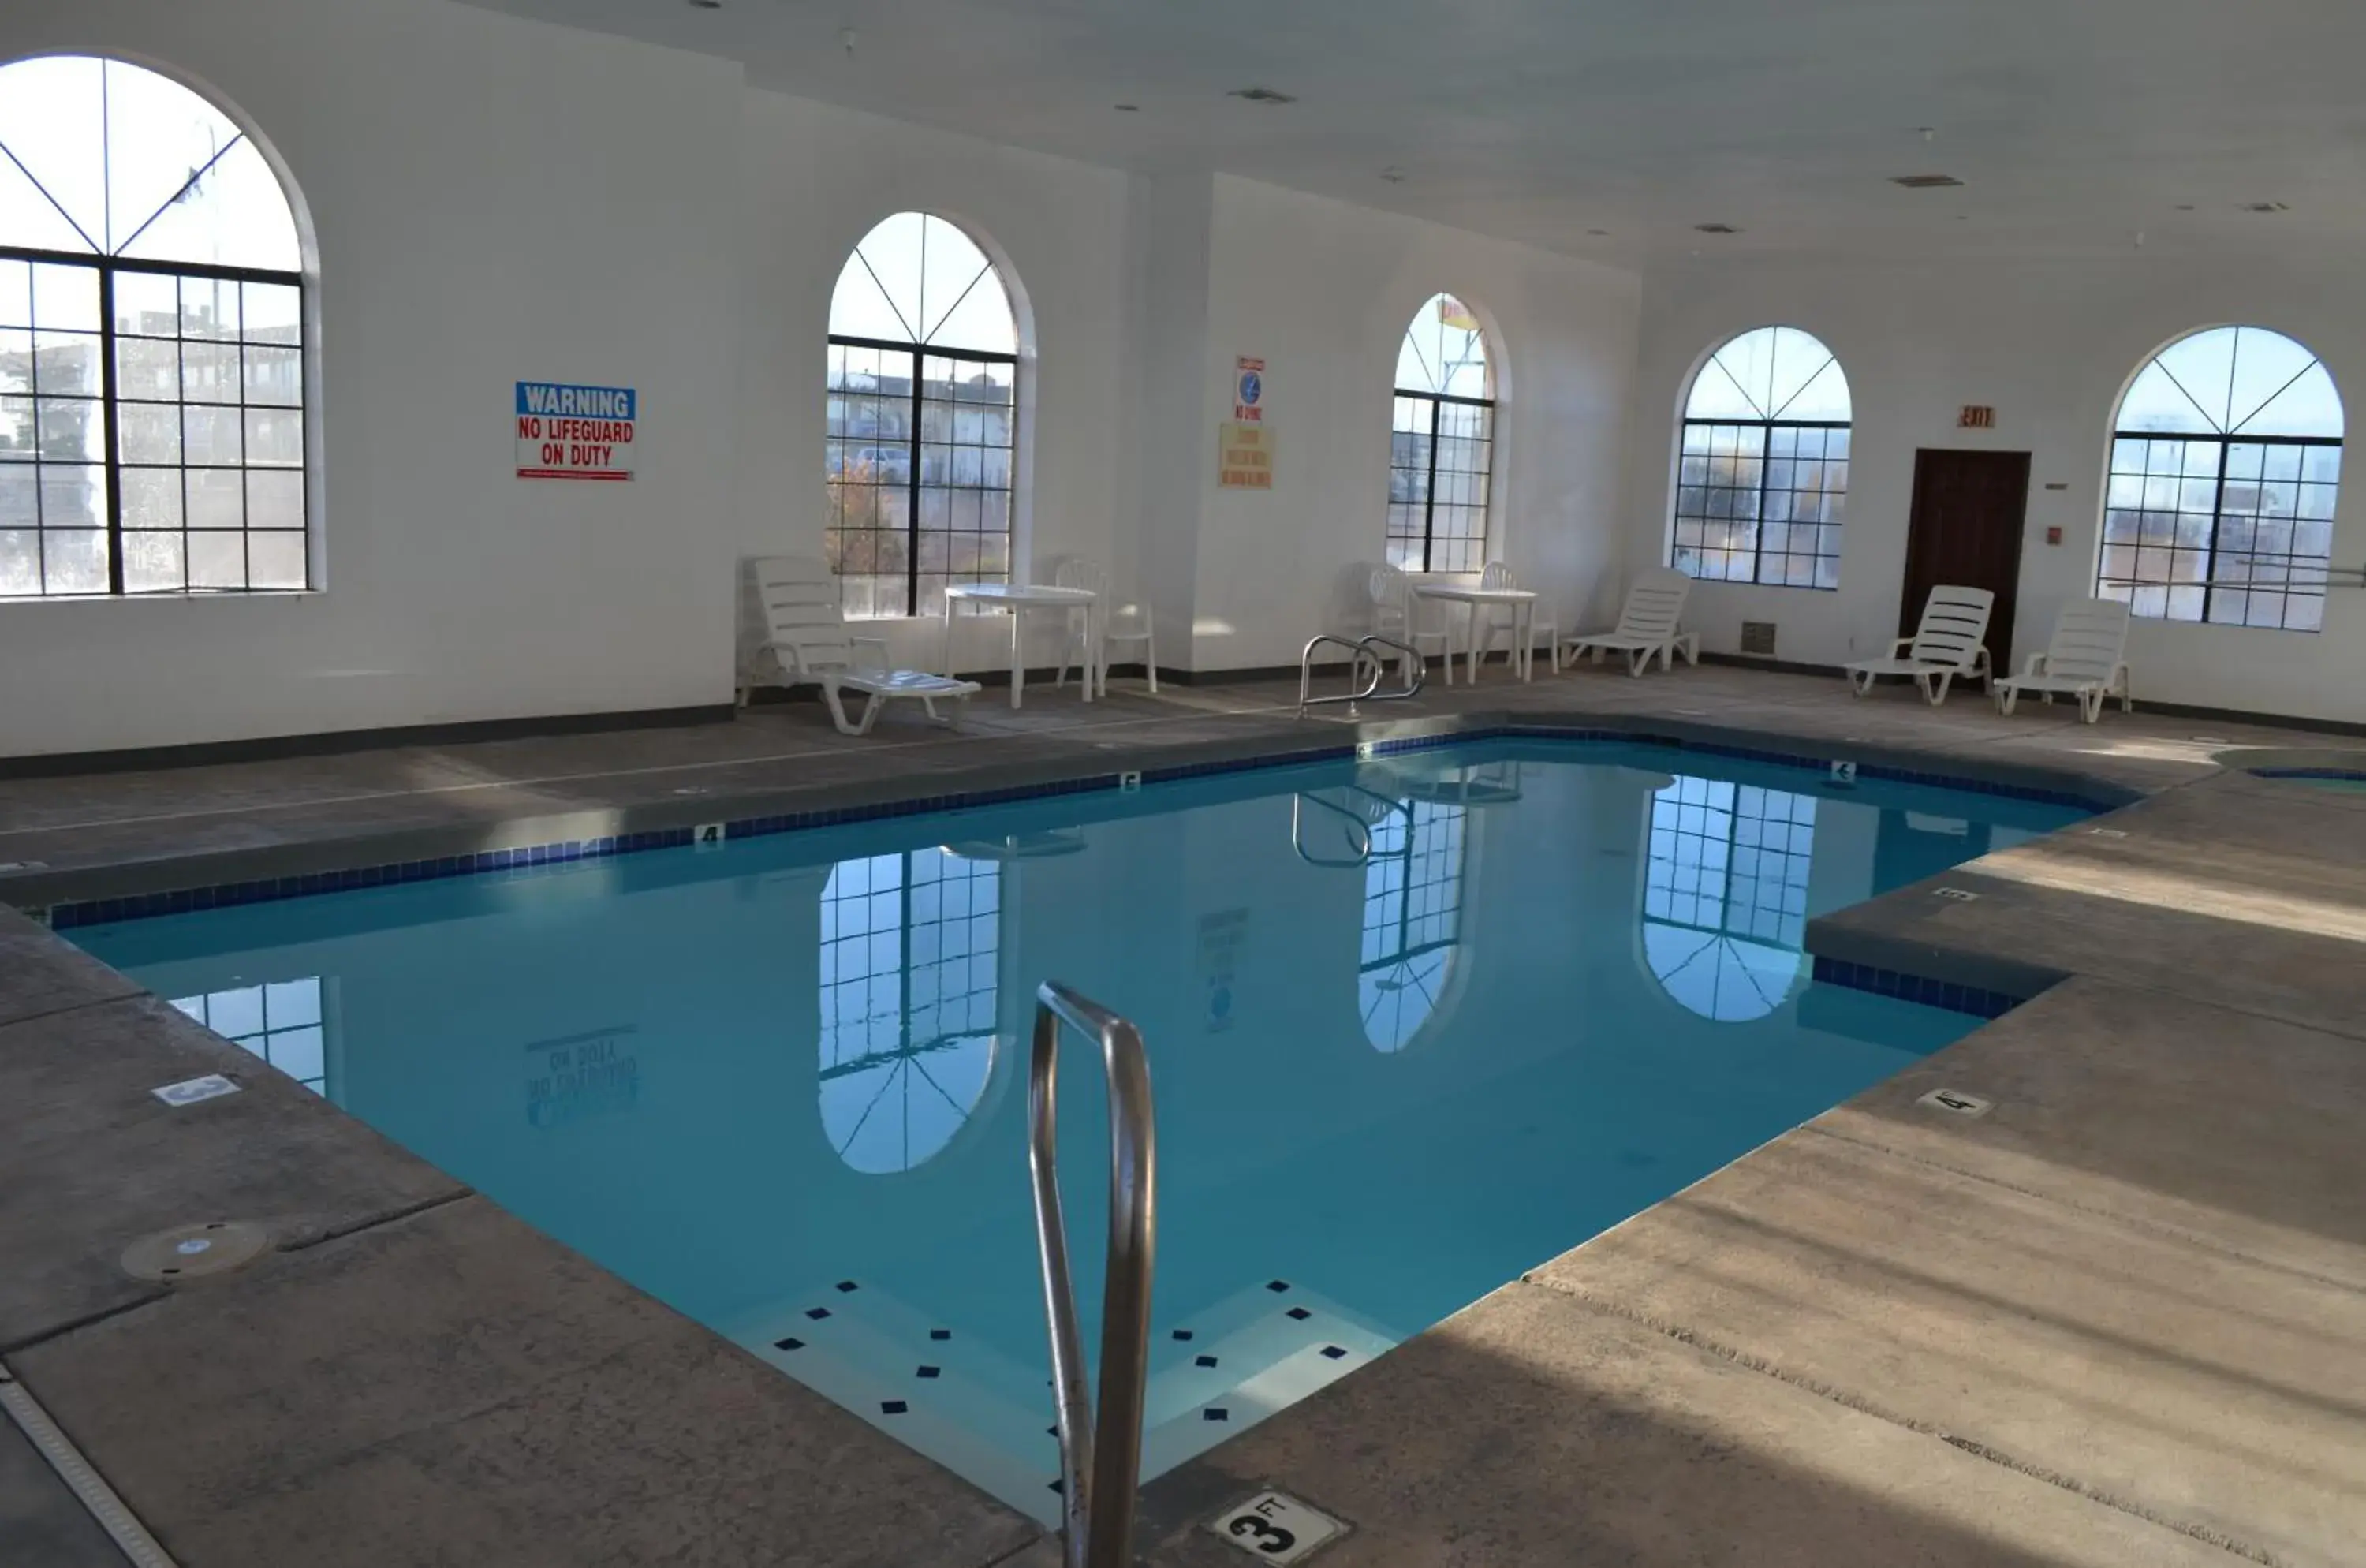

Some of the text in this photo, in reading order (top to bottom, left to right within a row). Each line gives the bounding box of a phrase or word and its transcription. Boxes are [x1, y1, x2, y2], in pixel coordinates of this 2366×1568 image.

[524, 385, 629, 417] WARNING
[518, 416, 633, 442] NO LIFEGUARD
[542, 443, 612, 466] ON DUTY
[1229, 1497, 1296, 1553] 3 FT
